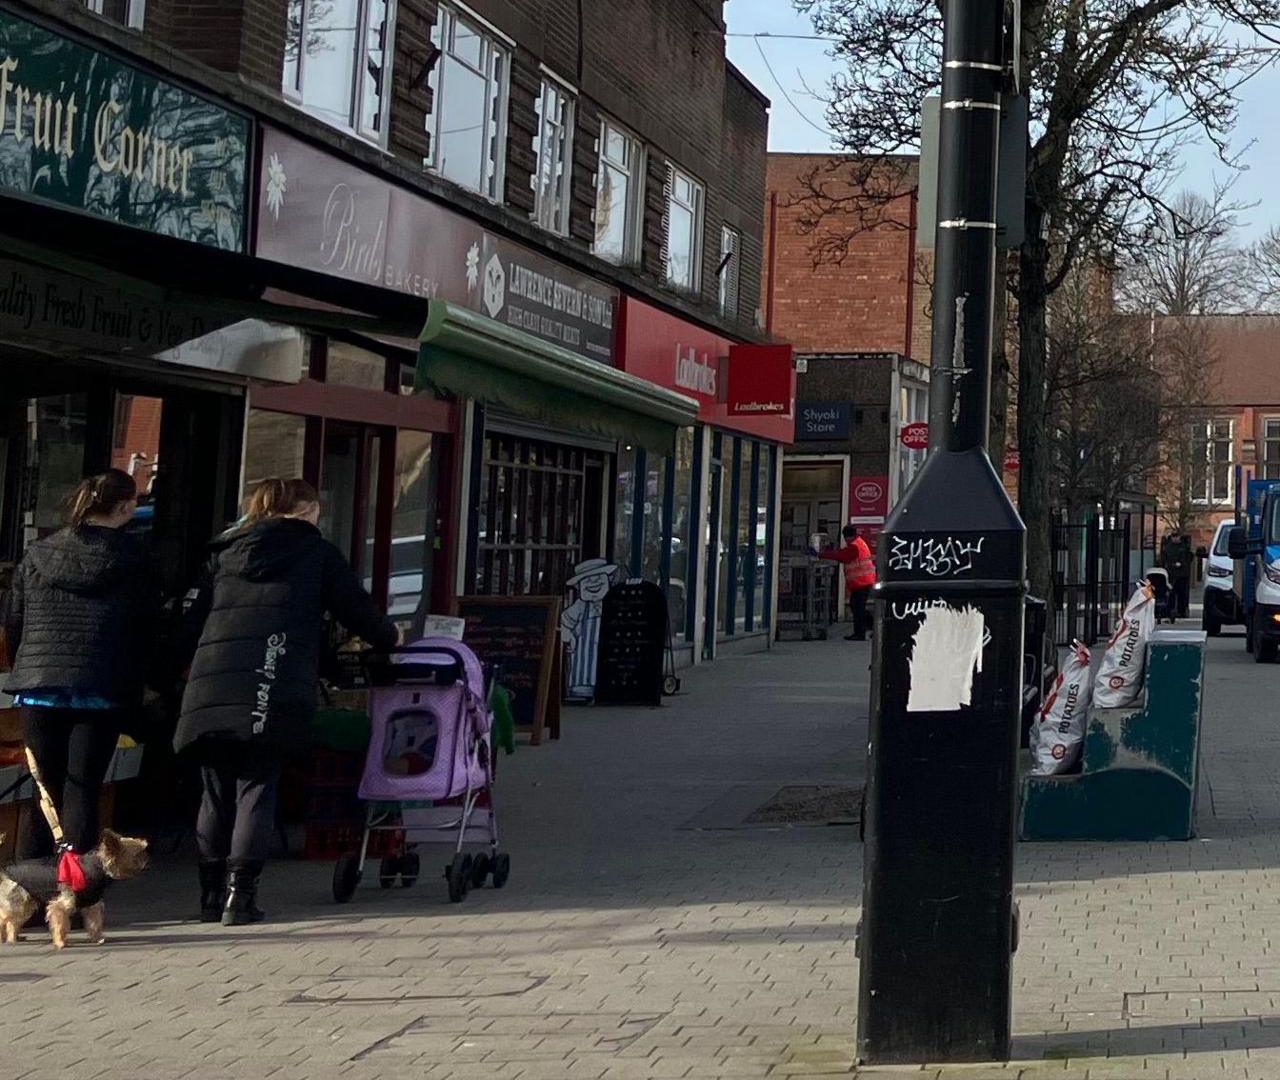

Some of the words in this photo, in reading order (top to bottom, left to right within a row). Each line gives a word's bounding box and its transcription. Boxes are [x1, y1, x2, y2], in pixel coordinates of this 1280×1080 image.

[94, 100, 195, 199] Corner
[385, 264, 440, 299] BAKERY
[733, 401, 785, 412] Ladbrokes
[806, 421, 836, 433] Store
[903, 435, 929, 444] OFFIC
[1118, 618, 1141, 668] POTATOES
[1058, 683, 1081, 735] POTATOES
